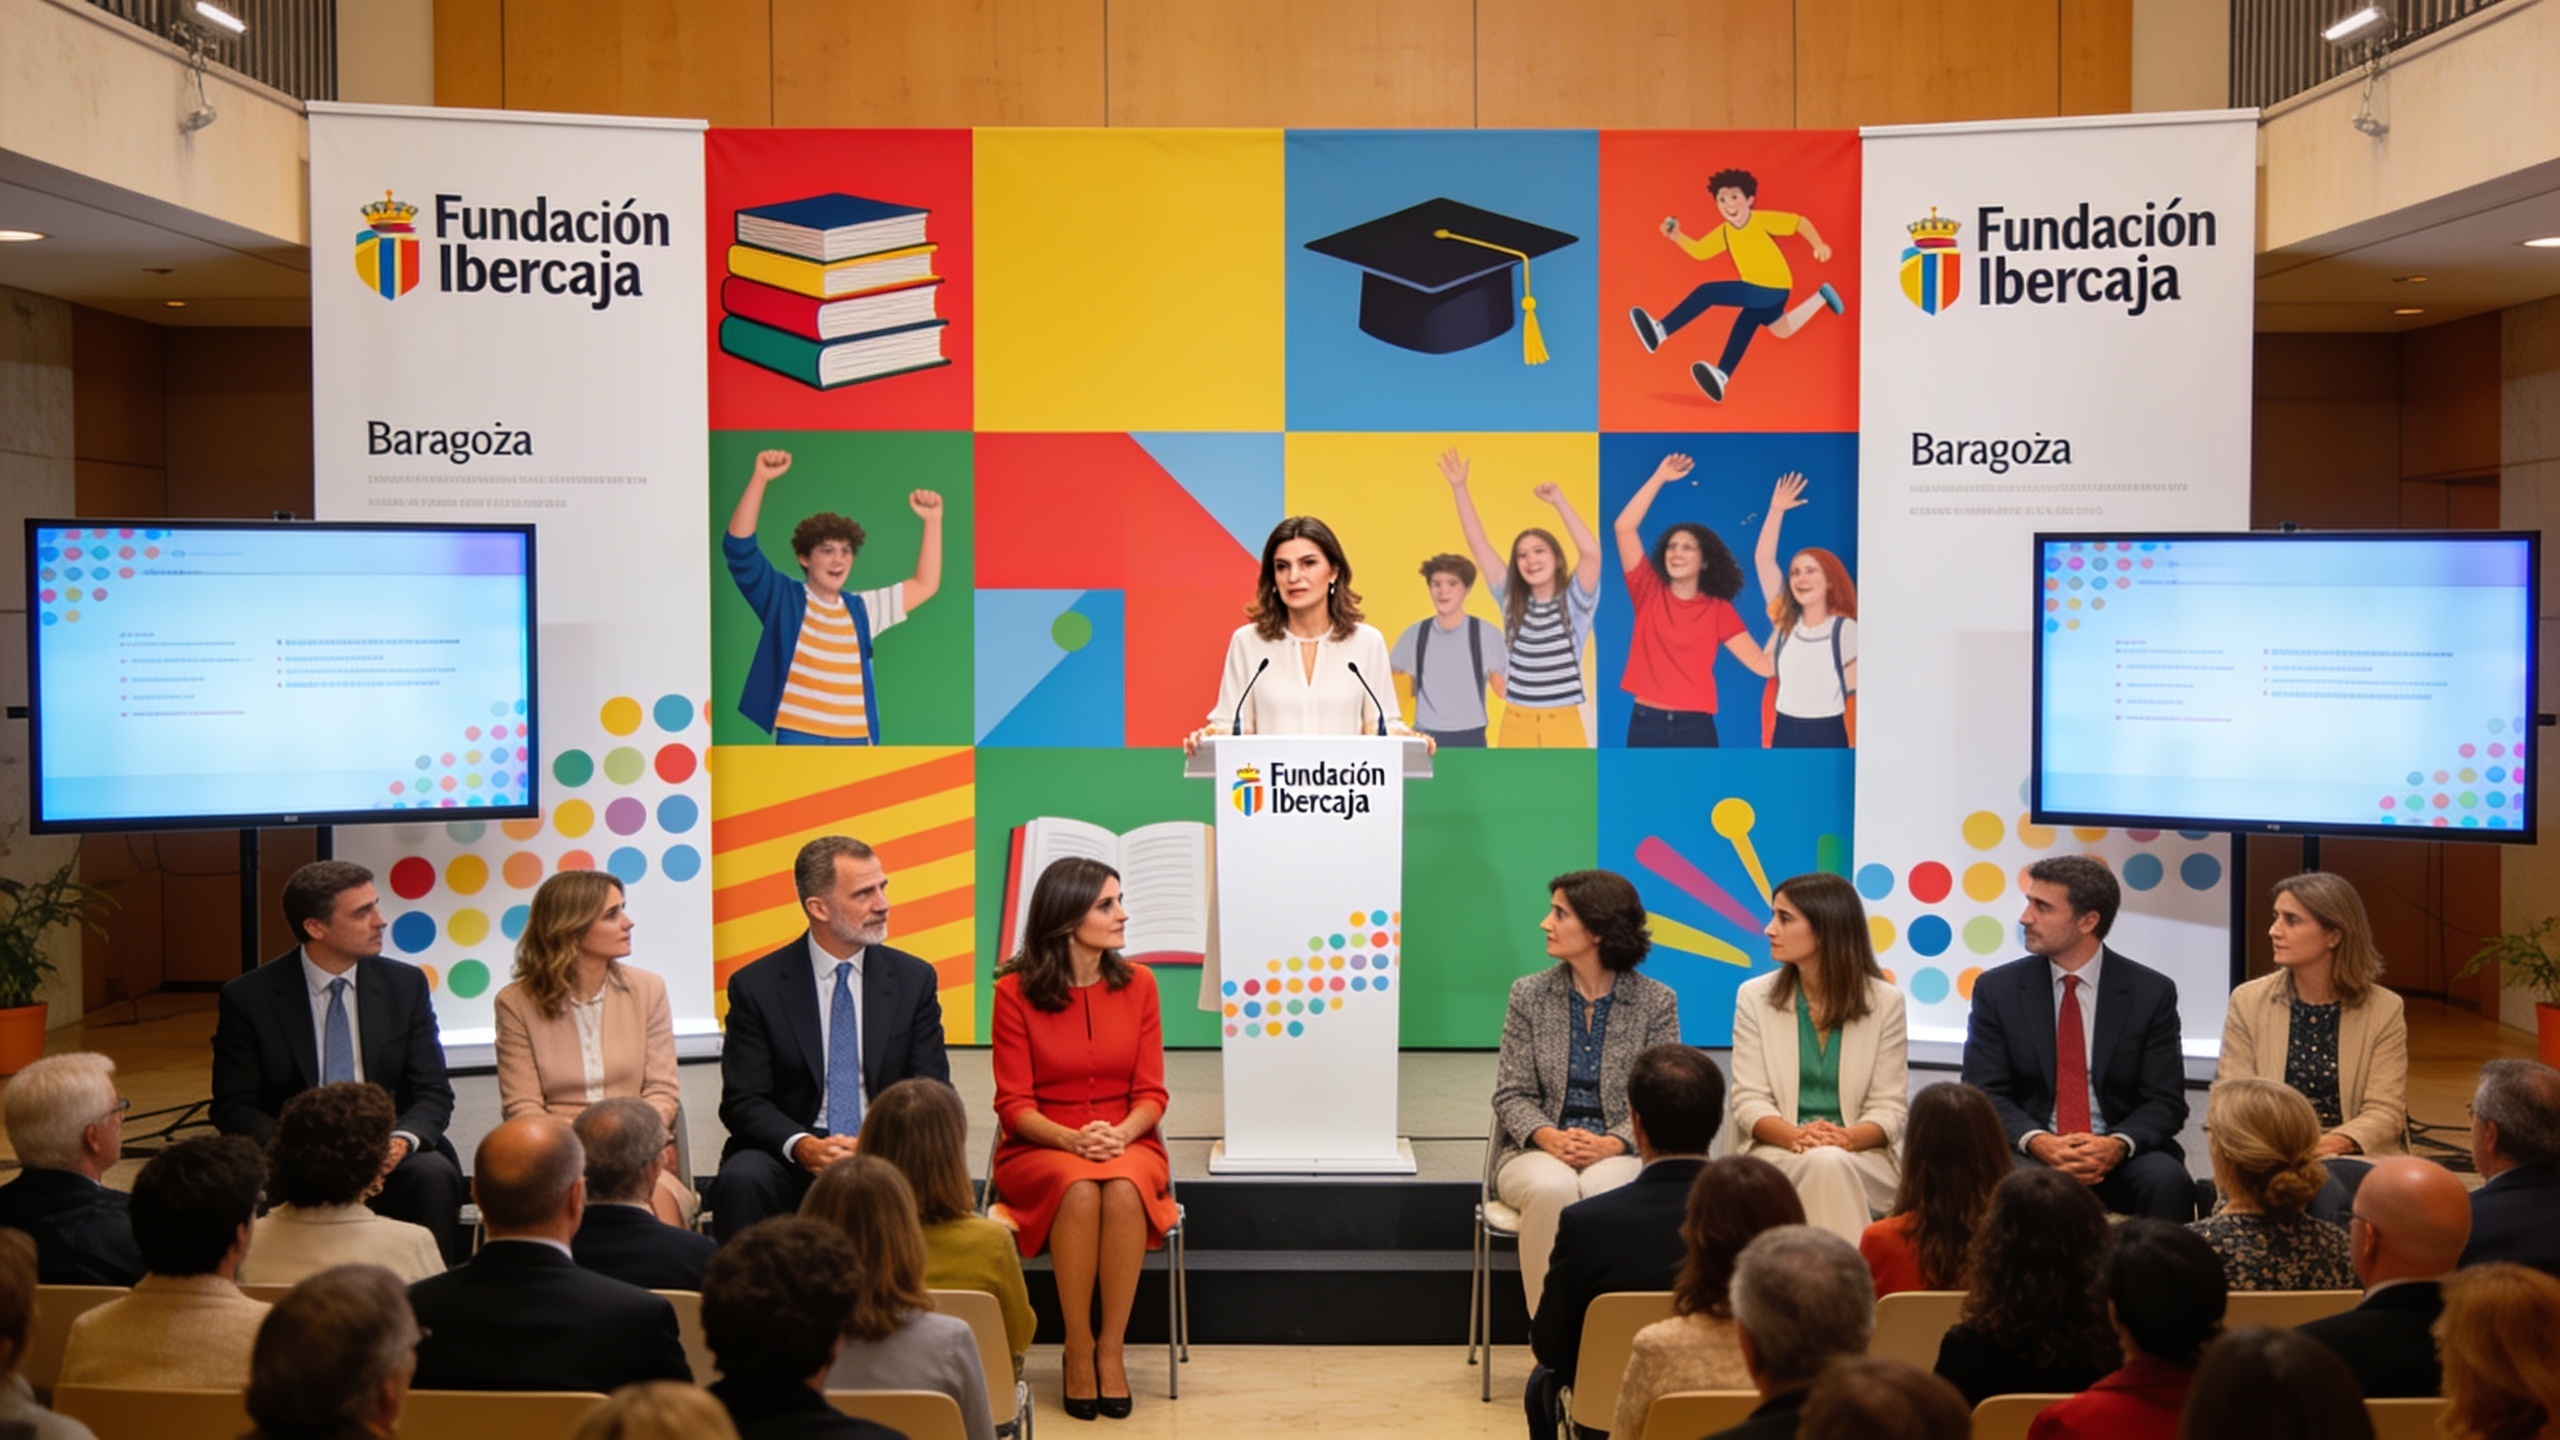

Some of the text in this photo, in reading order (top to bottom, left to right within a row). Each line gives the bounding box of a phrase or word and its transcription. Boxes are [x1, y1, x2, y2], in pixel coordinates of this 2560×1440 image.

[434, 193, 670, 247] Fundación
[1978, 197, 2217, 253] Fundación
[439, 243, 643, 311] Ibercaja
[1978, 254, 2182, 317] Ibercaja
[1270, 760, 1385, 787] Fundación
[1271, 787, 1370, 821] Ibercaja
